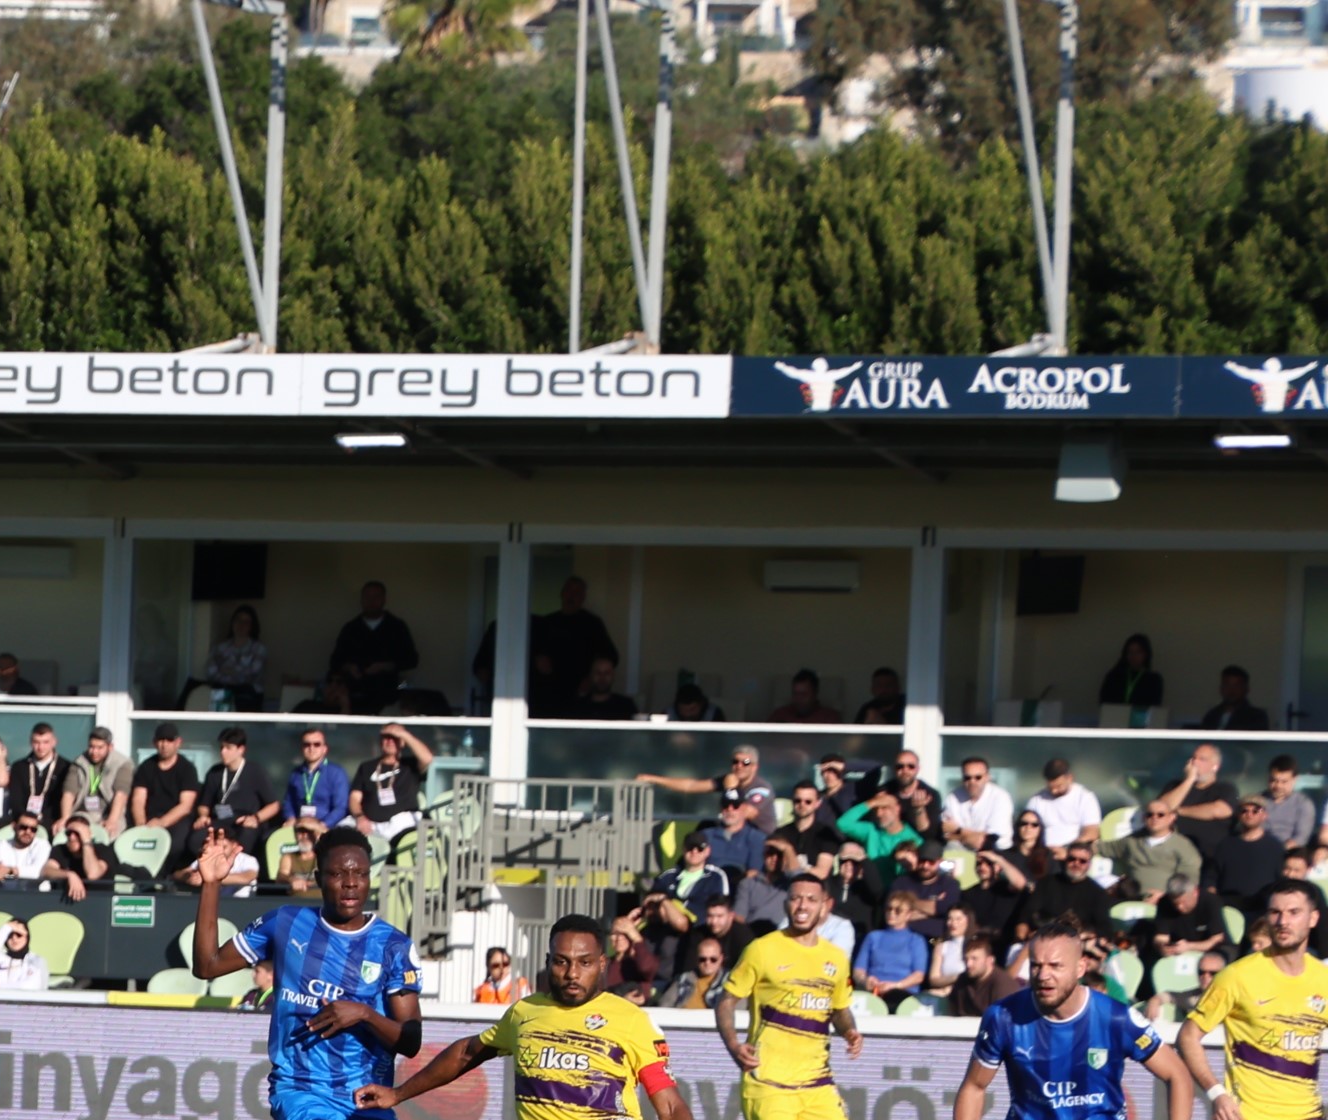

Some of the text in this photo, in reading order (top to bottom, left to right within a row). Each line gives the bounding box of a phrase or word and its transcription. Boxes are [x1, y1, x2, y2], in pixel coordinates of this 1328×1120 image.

[87, 355, 275, 396] beton
[868, 361, 924, 380] GRUP
[967, 362, 1132, 394] ACROPOL
[323, 358, 701, 409] grey beton
[841, 378, 950, 409] AURA
[1004, 391, 1090, 410] BODRUM
[281, 987, 320, 1009] TRAVEL
[539, 1047, 590, 1070] ikas
[1043, 1081, 1077, 1098] CIP
